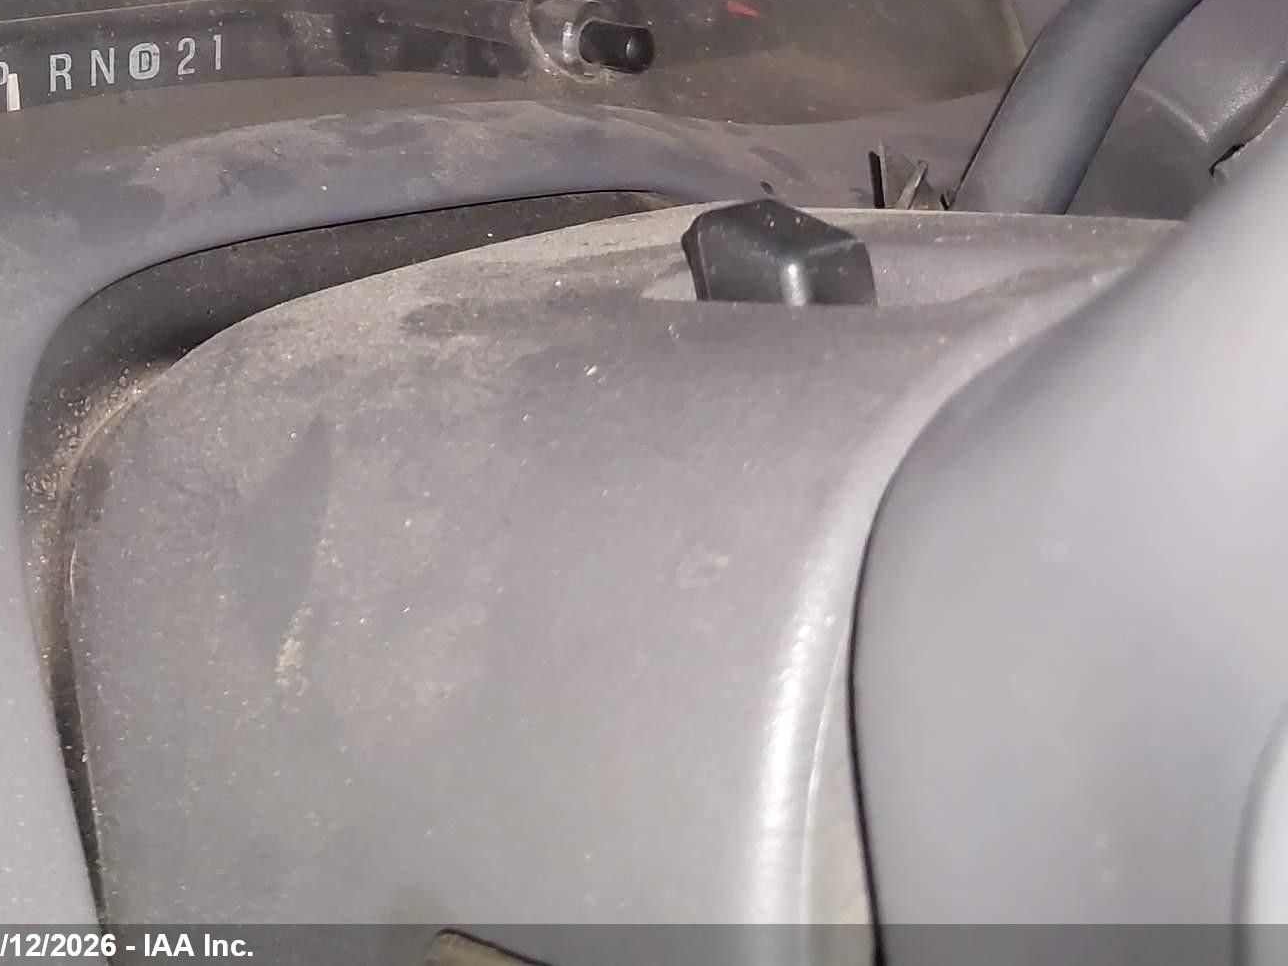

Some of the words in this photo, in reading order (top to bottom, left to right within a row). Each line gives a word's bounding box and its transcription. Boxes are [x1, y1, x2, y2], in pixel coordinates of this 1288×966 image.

[49, 53, 73, 92] R
[89, 46, 116, 87] N
[176, 36, 197, 77] 2
[212, 33, 223, 71] 1
